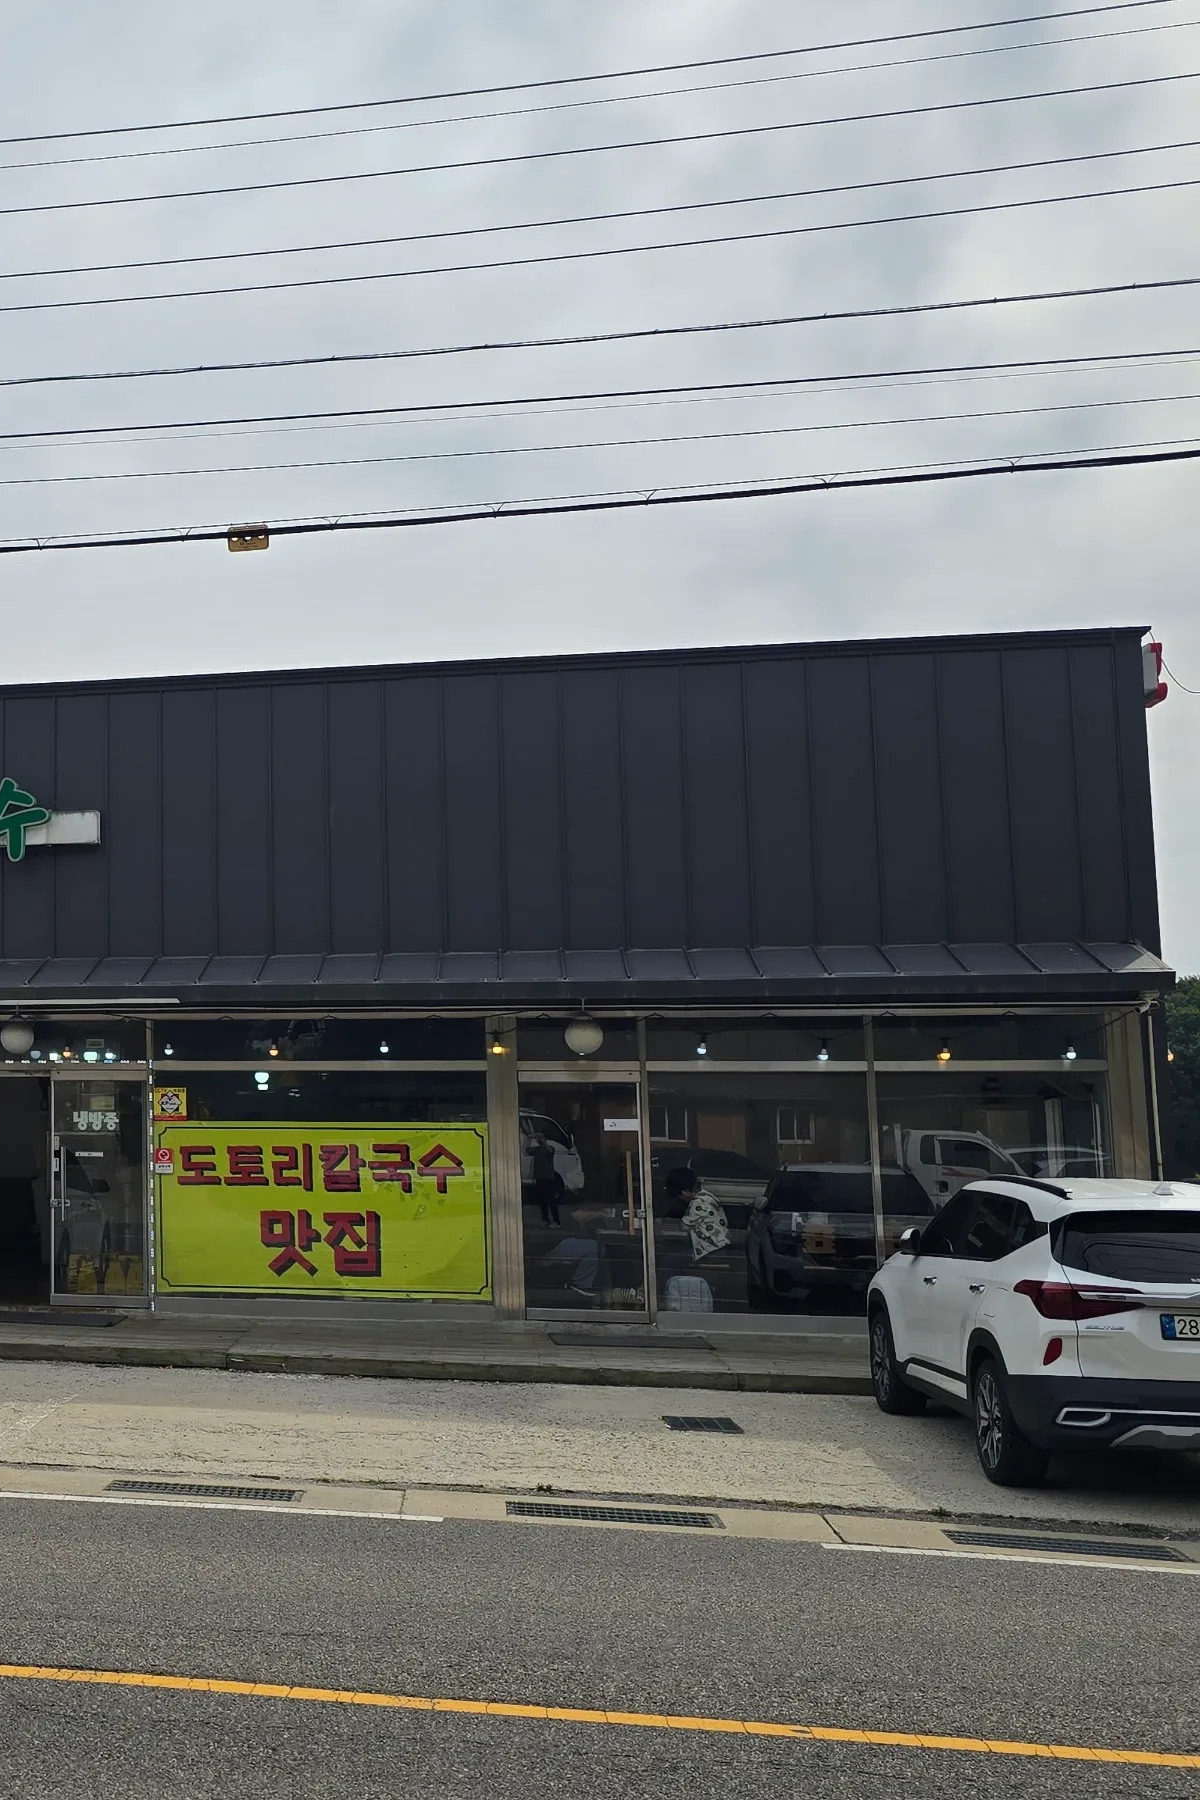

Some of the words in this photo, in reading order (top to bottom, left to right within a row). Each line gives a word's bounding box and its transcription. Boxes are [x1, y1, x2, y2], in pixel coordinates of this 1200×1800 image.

[73, 1111, 120, 1131] 냉방중
[177, 1143, 465, 1194] 도토리칼국수
[260, 1209, 382, 1277] 맛집
[1177, 1318, 1200, 1336] 28
